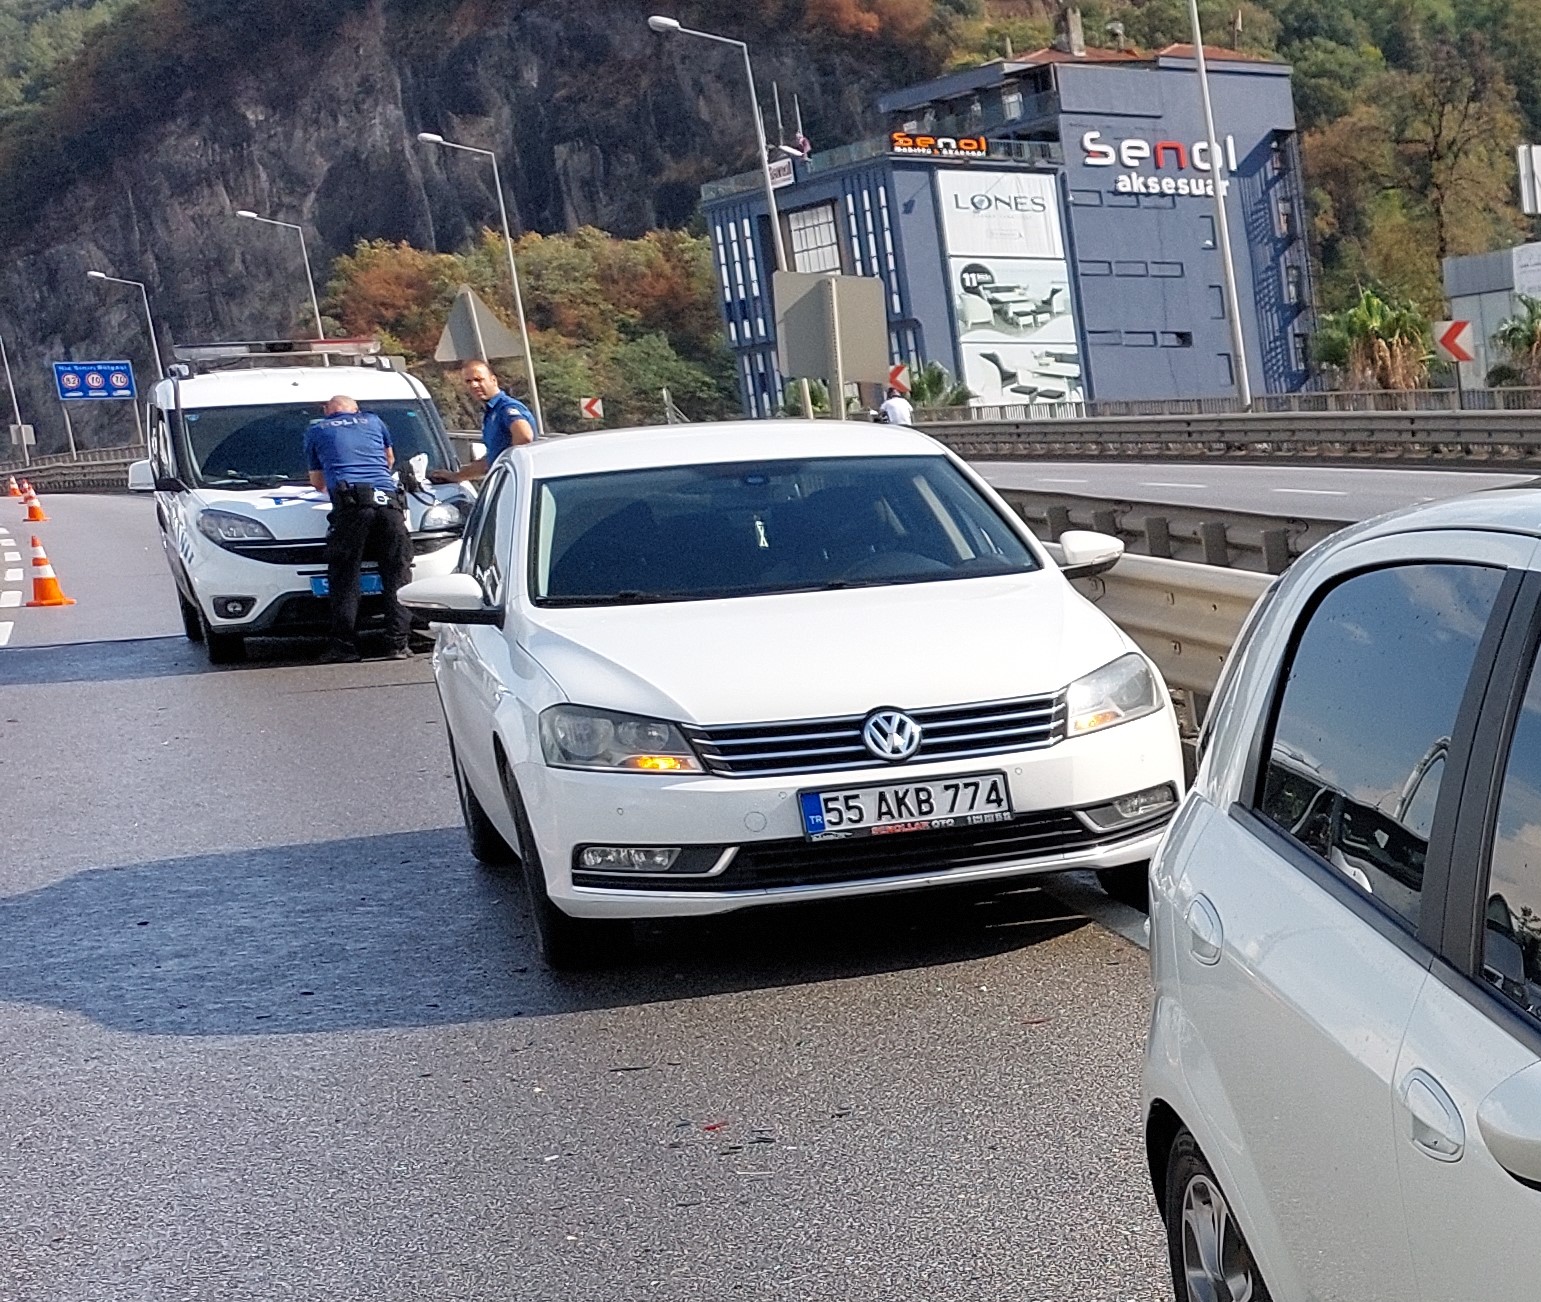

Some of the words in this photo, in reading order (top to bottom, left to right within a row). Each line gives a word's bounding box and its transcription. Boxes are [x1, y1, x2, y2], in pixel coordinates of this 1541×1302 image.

[1116, 172, 1229, 197] aksesuar
[953, 193, 1047, 213] LONES
[822, 793, 865, 826] 55
[876, 785, 936, 822] AKB
[943, 778, 1004, 814] 774
[809, 814, 824, 825] TR
